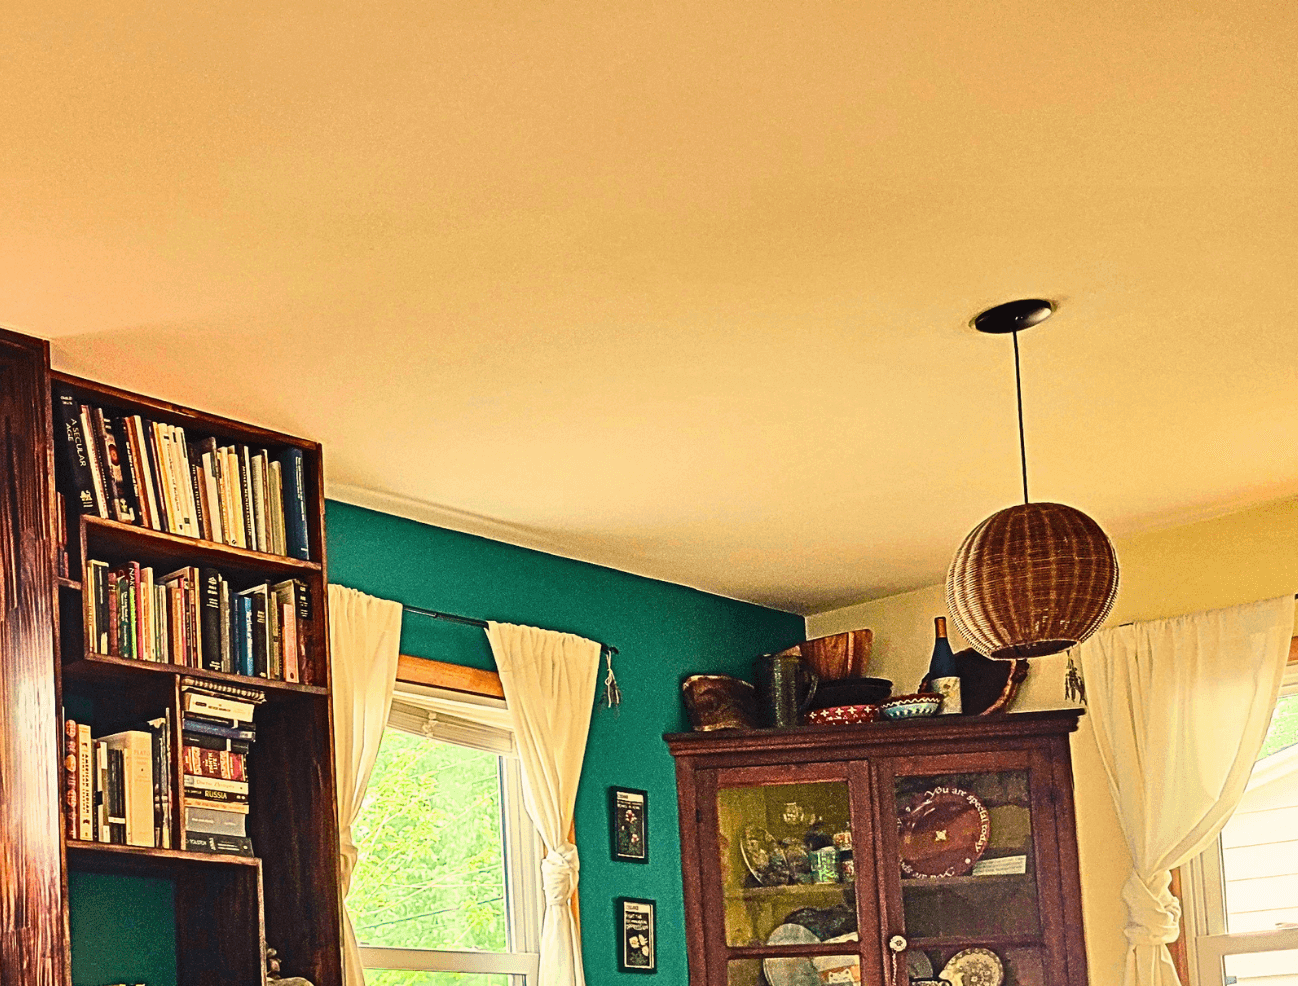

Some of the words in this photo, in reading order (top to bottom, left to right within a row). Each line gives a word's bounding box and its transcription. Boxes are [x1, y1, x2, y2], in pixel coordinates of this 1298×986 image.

[65, 423, 74, 442] AGE
[73, 427, 87, 467] SECULAR
[204, 789, 228, 801] RUSSIA
[924, 786, 950, 801] You
[951, 788, 967, 798] are
[965, 794, 990, 823] special
[974, 823, 989, 853] today
